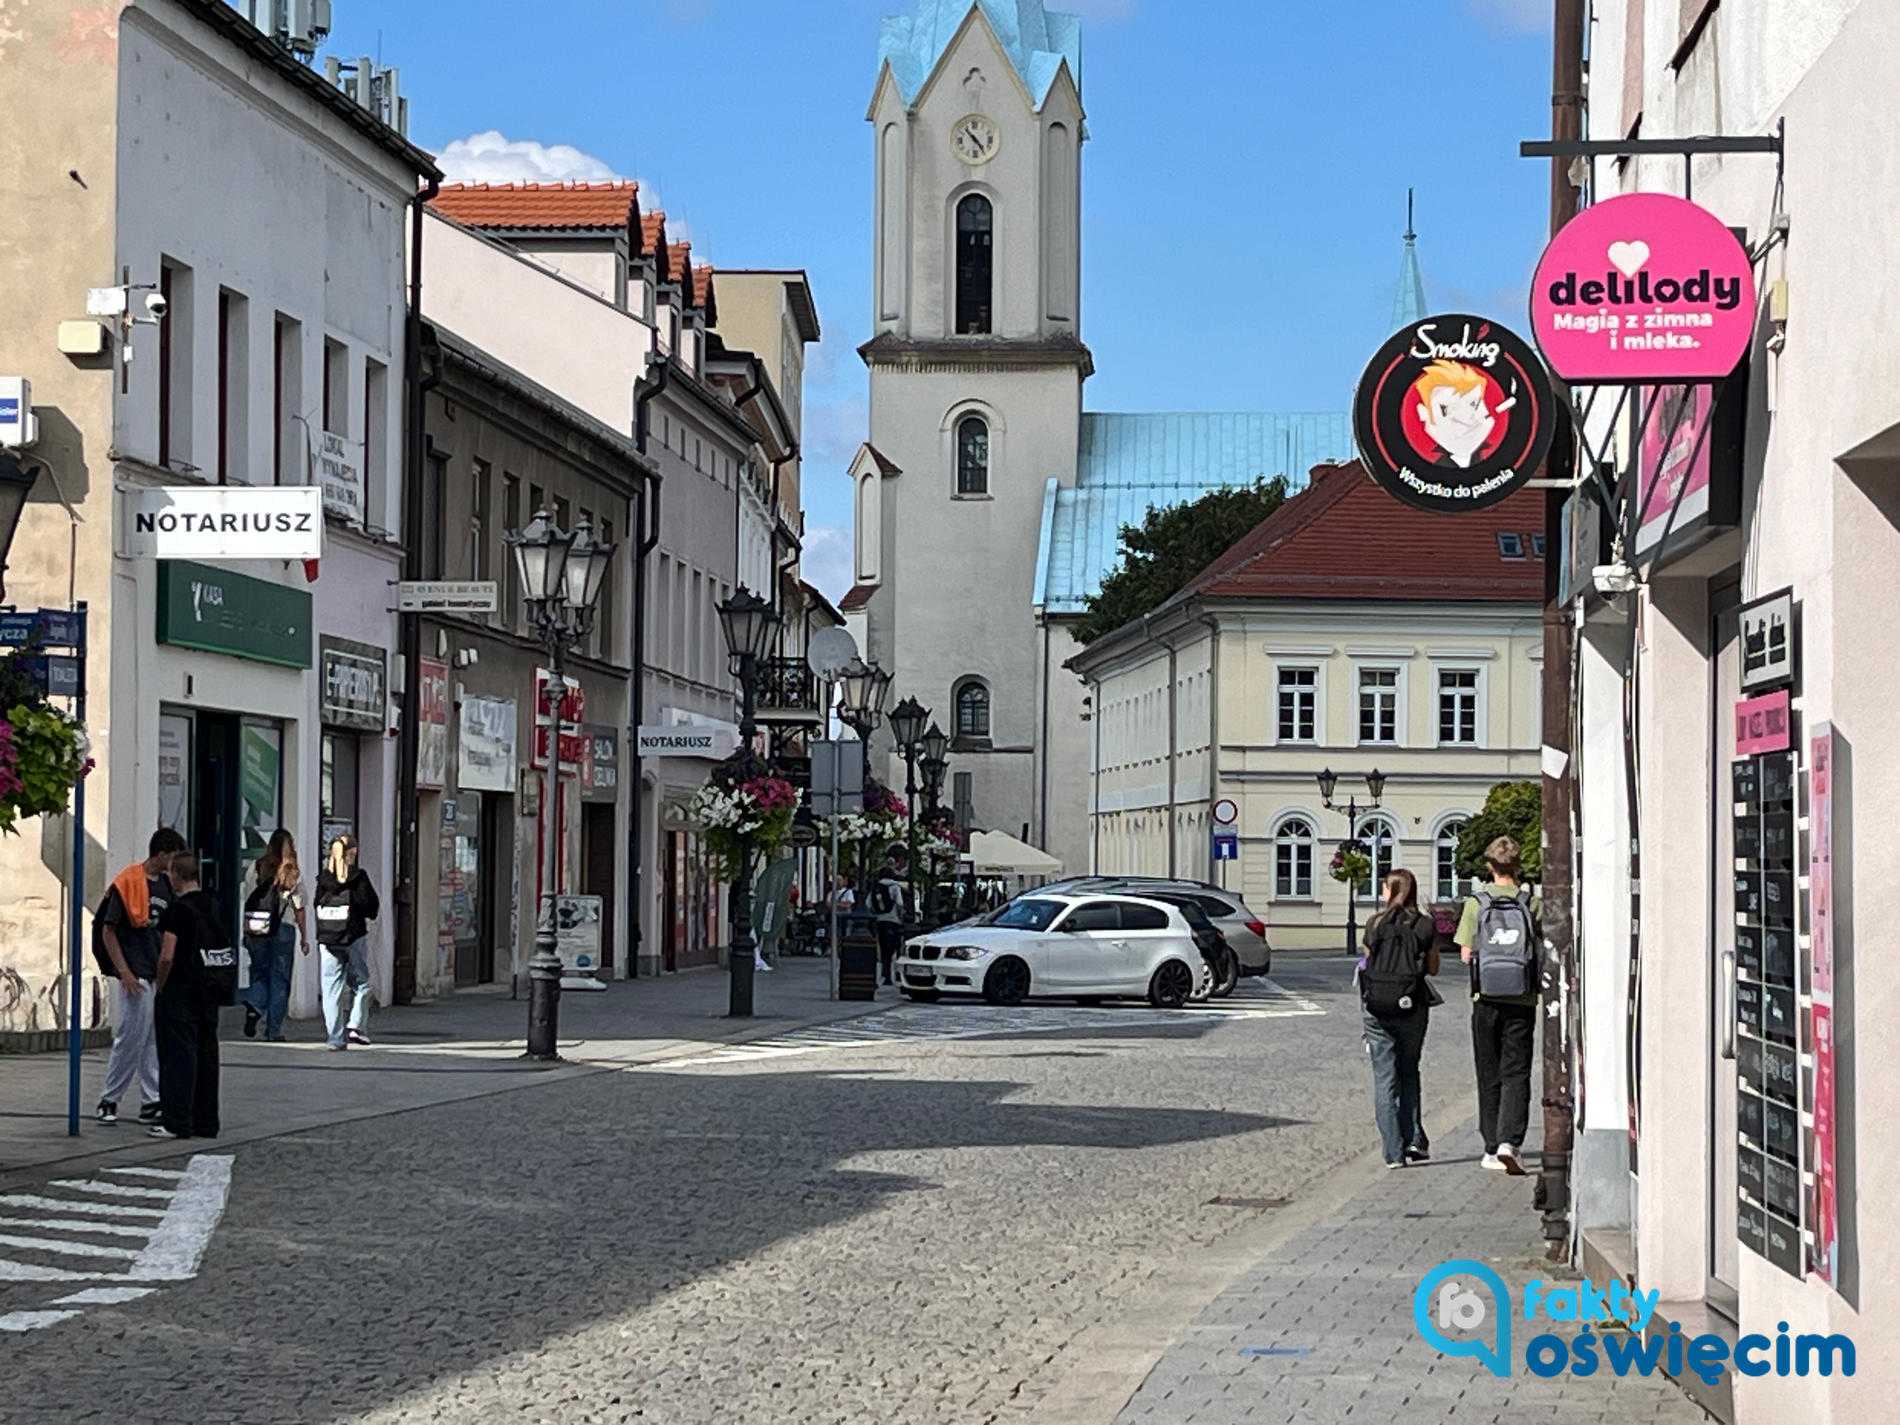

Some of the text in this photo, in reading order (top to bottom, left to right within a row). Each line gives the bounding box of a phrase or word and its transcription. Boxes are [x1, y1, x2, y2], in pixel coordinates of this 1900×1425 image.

[1549, 269, 1741, 311] delilody
[1554, 309, 1713, 333] Magia z zimna
[1410, 324, 1501, 367] Smoking
[1609, 329, 1700, 350] i mleka.
[1399, 466, 1514, 498] Wszystko do palenia
[136, 512, 312, 533] NOTARIUSZ
[640, 736, 712, 748] NOTARIUSZ
